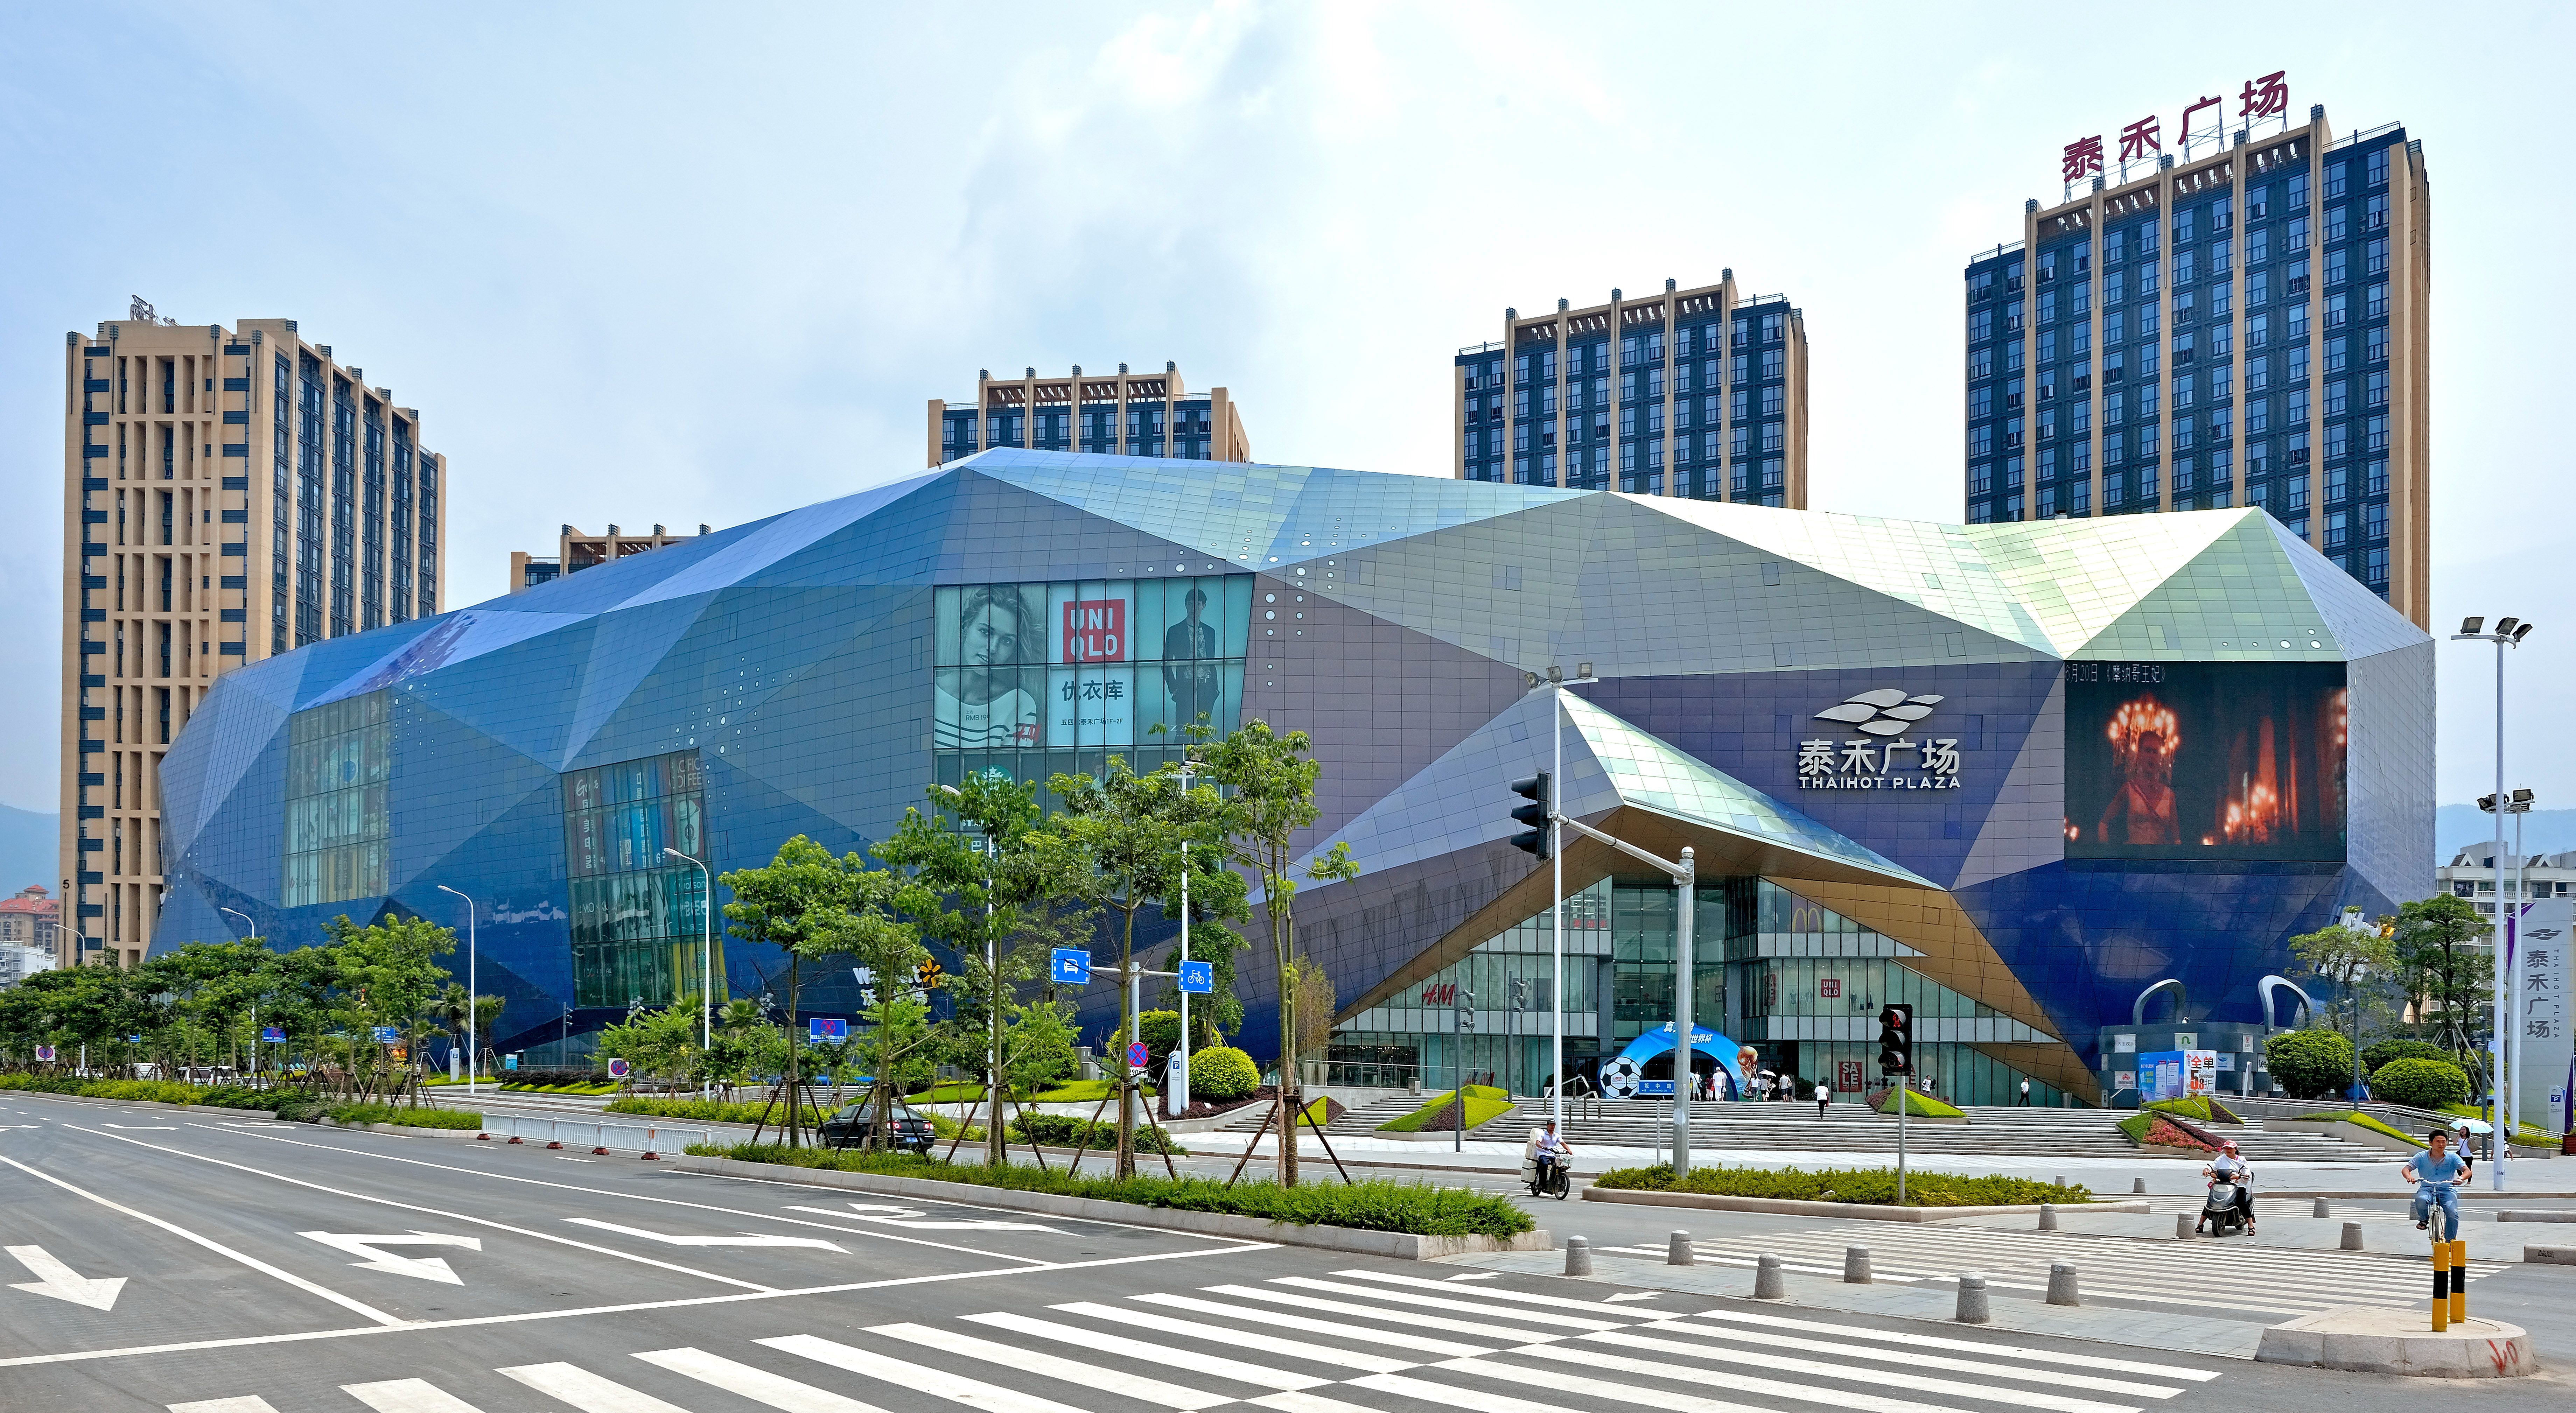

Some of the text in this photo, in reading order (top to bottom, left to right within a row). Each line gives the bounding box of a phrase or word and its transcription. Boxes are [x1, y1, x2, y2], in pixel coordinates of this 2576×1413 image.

[2063, 70, 2288, 182] 泰禾广场
[1070, 609, 1113, 630] UNI
[1070, 635, 1117, 661] QLO
[2065, 663, 2097, 683] 6月20日
[1062, 679, 1123, 701] 优衣库
[1799, 738, 1960, 775] 泰禾广场
[1799, 776, 1960, 789] THAIHOT PLAZA
[63, 879, 69, 889] 5
[1423, 983, 1455, 1006] H&M
[2527, 950, 2549, 1038] 泰禾广场
[2191, 1055, 2214, 1070] 全单
